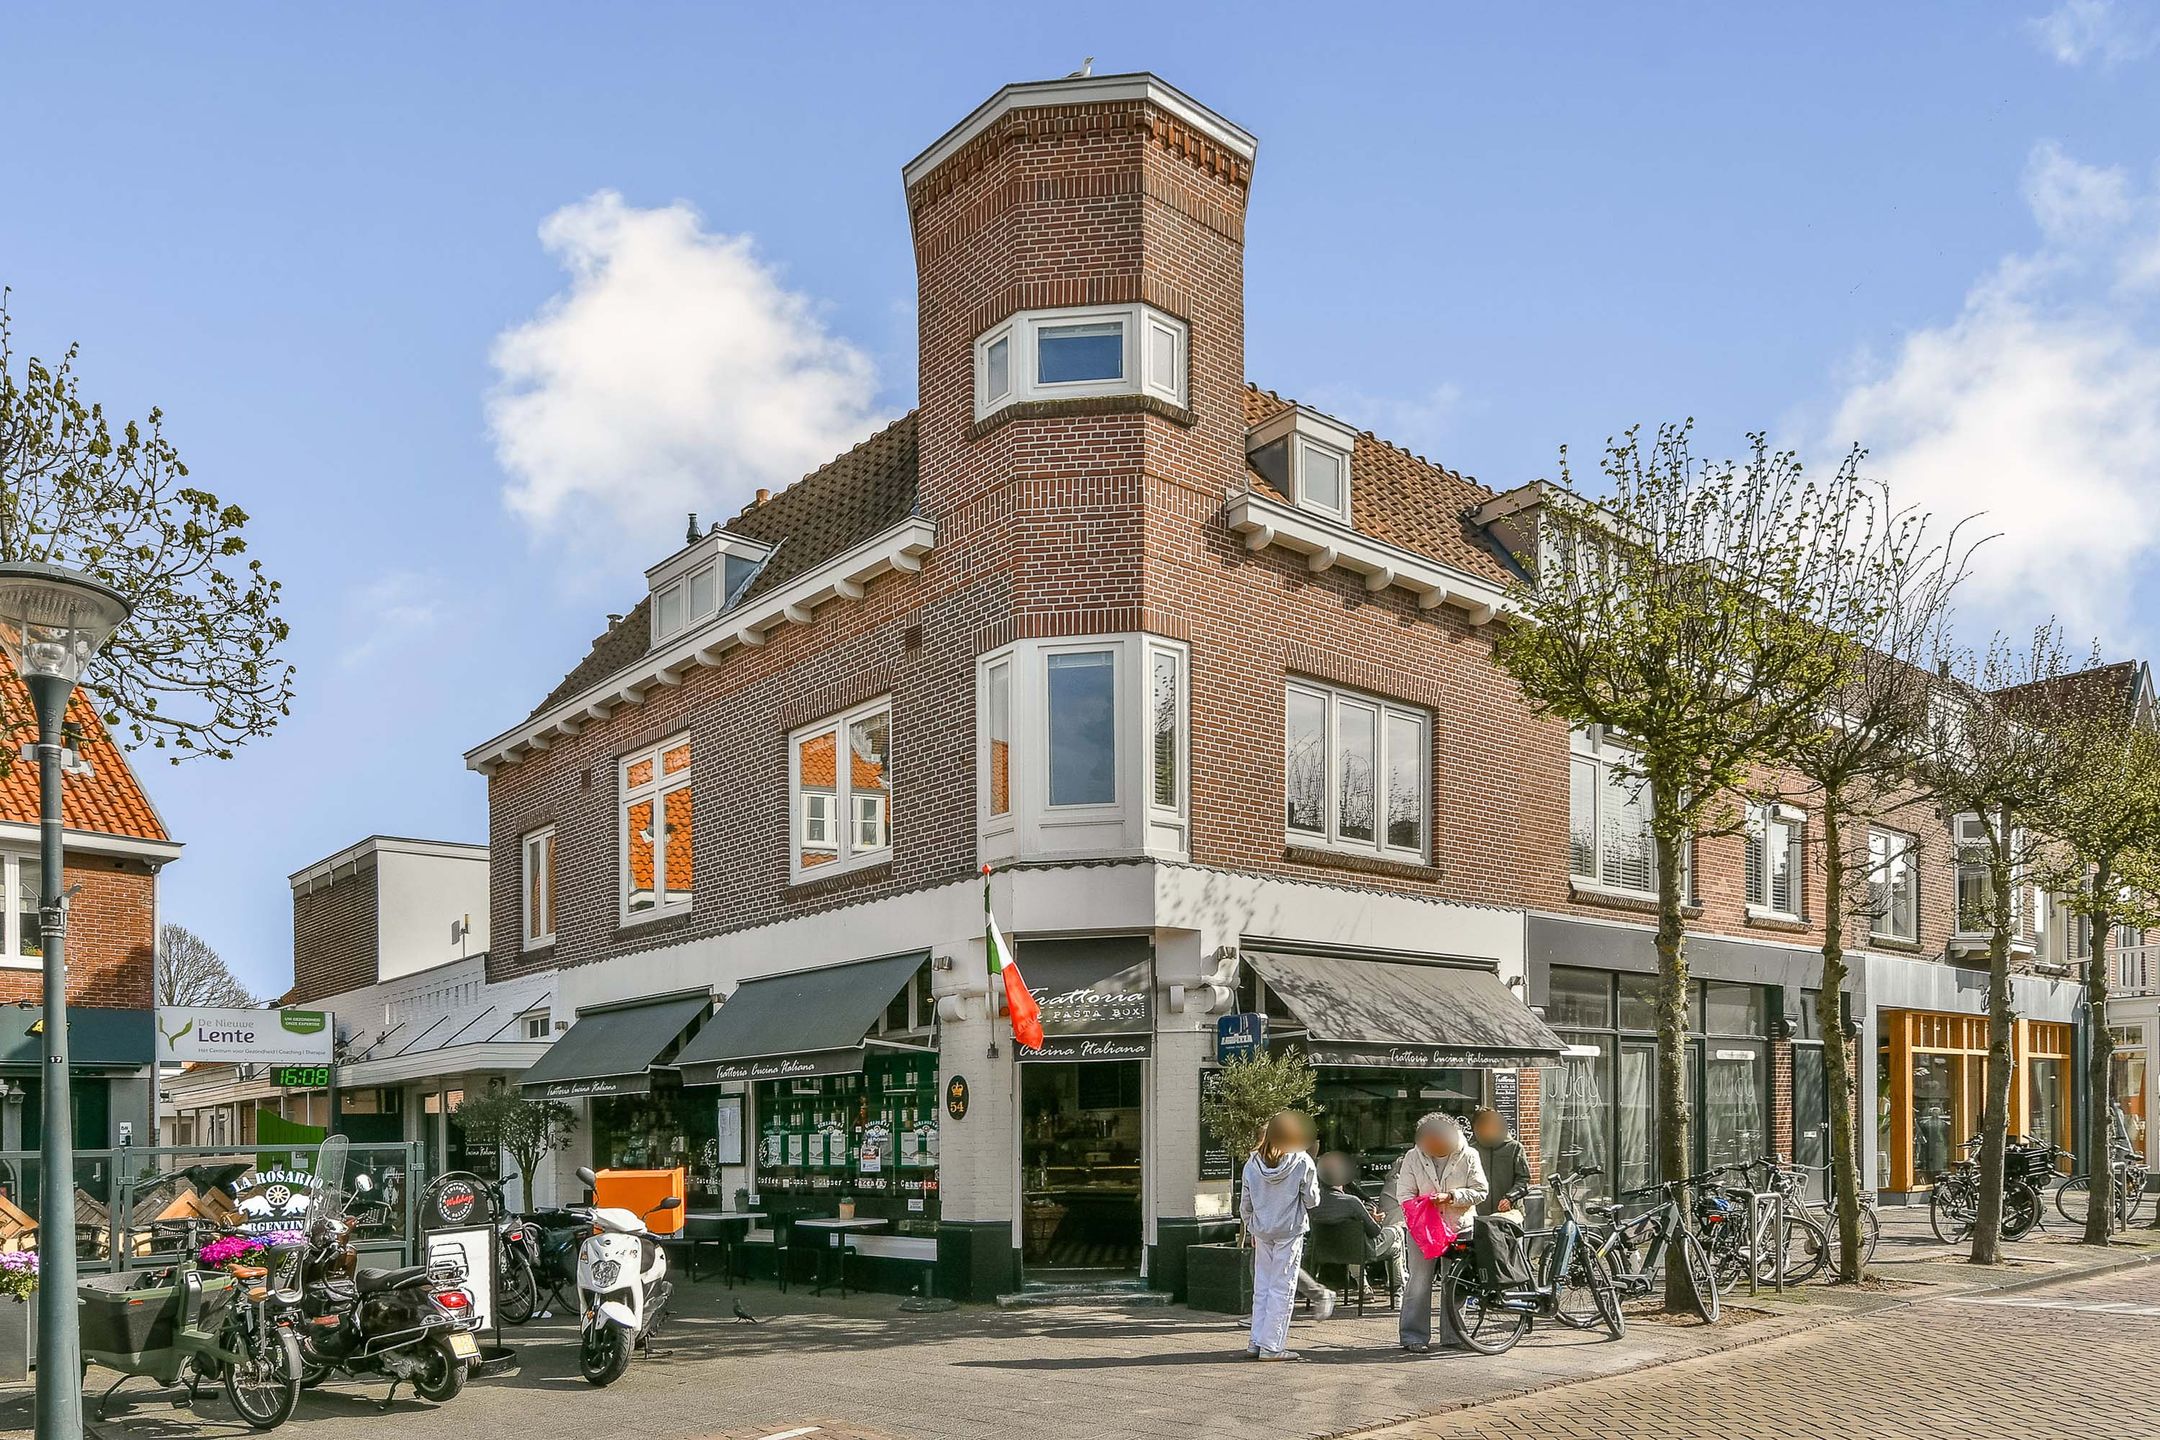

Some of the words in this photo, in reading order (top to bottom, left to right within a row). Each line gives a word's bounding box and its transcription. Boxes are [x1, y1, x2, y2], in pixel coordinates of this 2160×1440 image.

[1028, 987, 1146, 1005] Trattoria
[1053, 1009, 1102, 1019] PASTA
[1112, 1007, 1141, 1017] BOX
[198, 1018, 212, 1027] De
[215, 1018, 255, 1028] Nieuwe
[198, 1027, 255, 1043] Lente
[1020, 1044, 1076, 1057] Cucina
[1080, 1040, 1146, 1056] Italiana
[1389, 1047, 1429, 1062] Trattoria
[1433, 1050, 1464, 1063] Cucina
[1465, 1051, 1501, 1065] Italiana
[280, 1068, 329, 1086] 16:08
[716, 1064, 748, 1079] Trattoria
[751, 1062, 779, 1076] Cucina
[780, 1059, 815, 1074] Italiana
[950, 1101, 964, 1112] 54
[230, 1176, 252, 1192] LA
[255, 1170, 324, 1190] ROSARIO
[240, 1220, 304, 1232] RGENTIN
